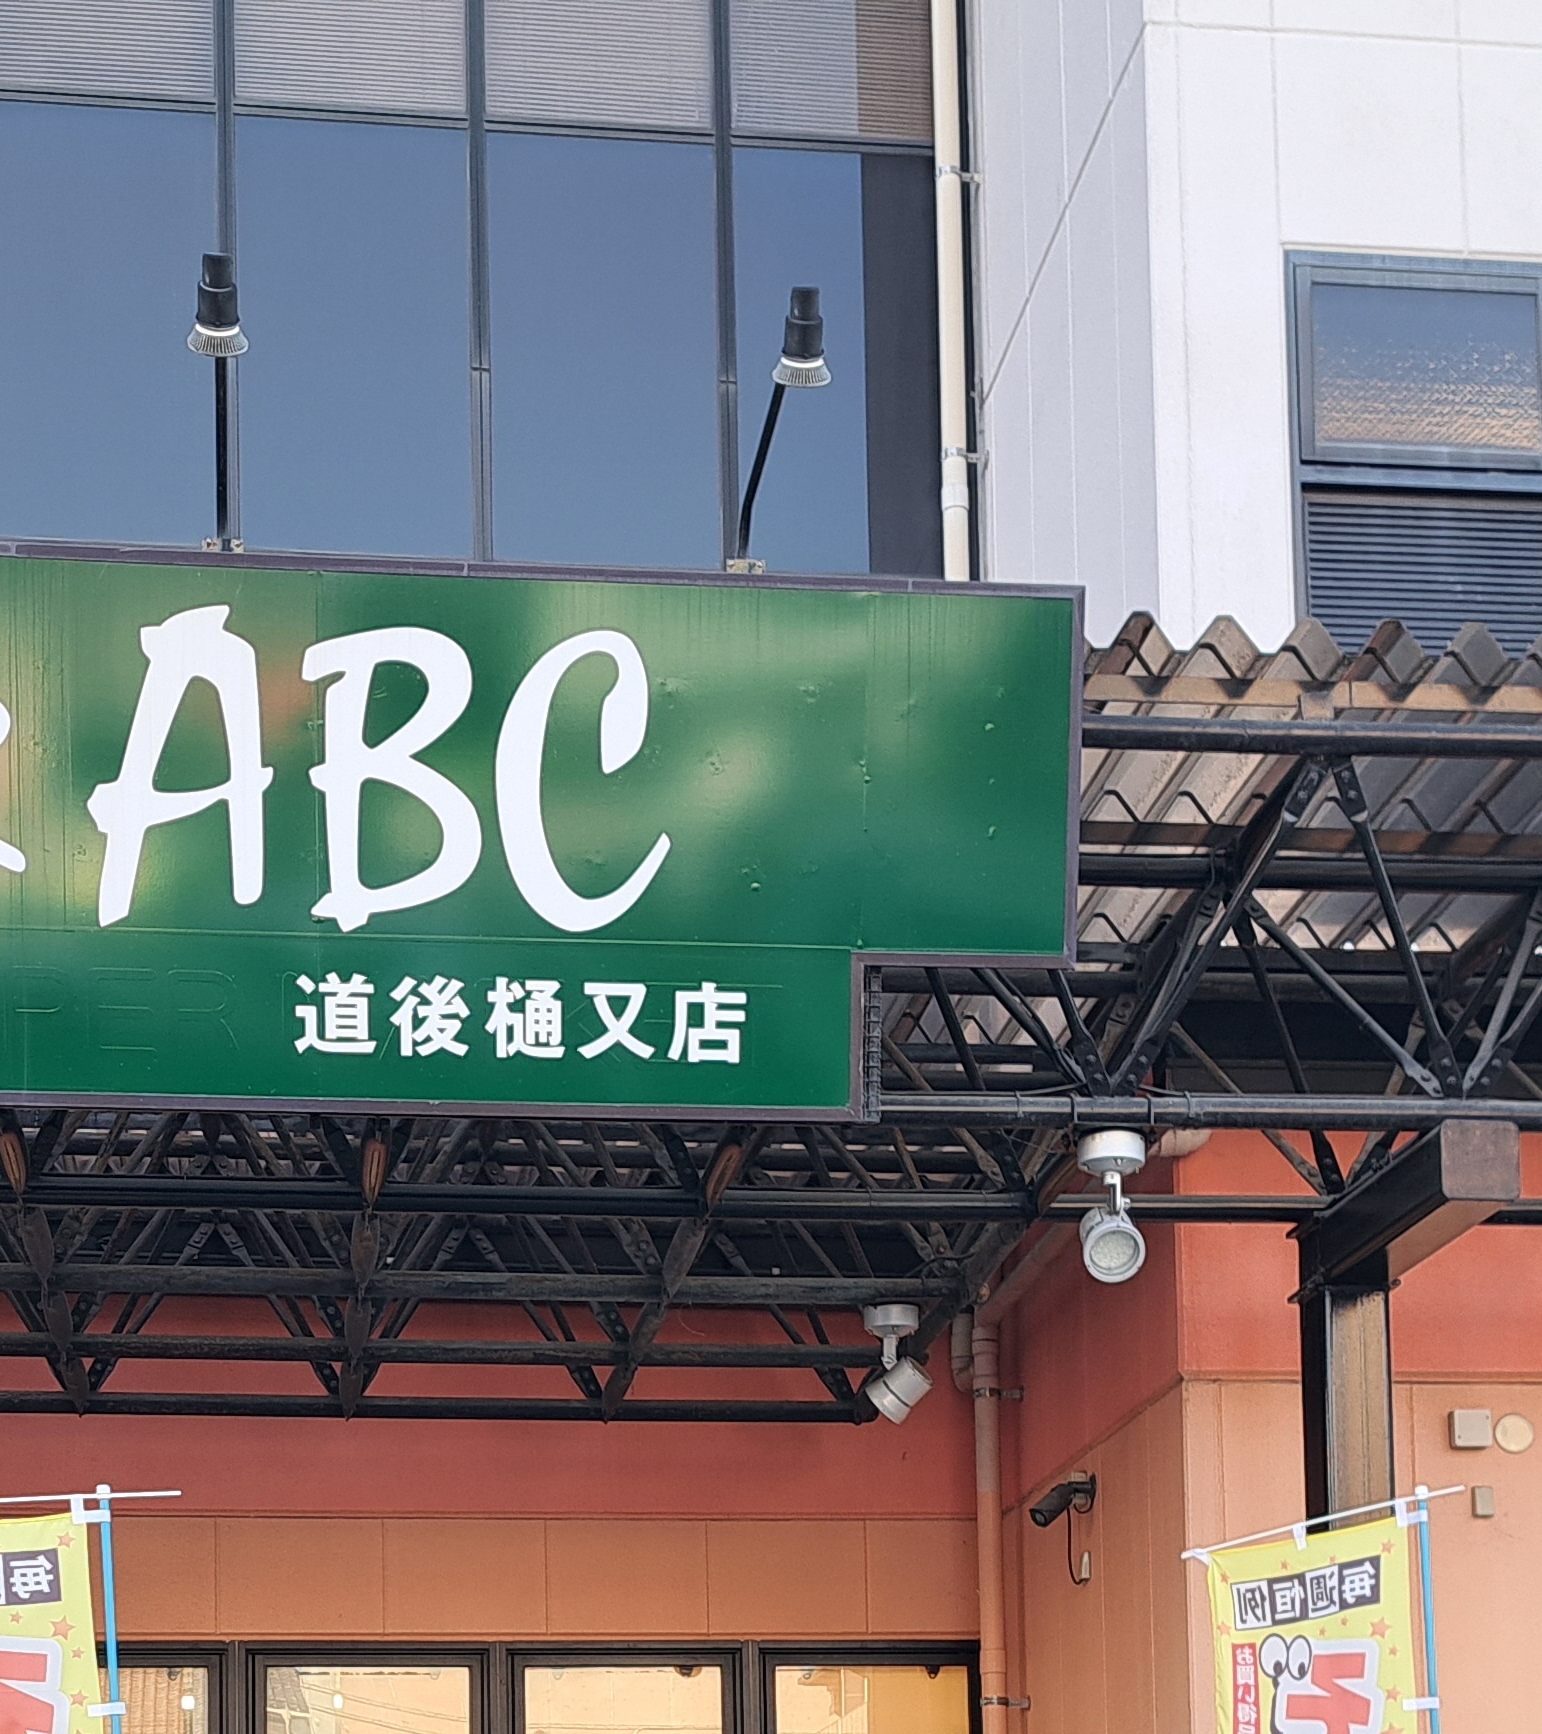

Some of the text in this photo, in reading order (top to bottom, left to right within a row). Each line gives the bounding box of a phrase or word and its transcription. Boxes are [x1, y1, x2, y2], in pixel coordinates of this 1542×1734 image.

[86, 605, 672, 932] ABC
[294, 971, 747, 1064] 道後樋又店
